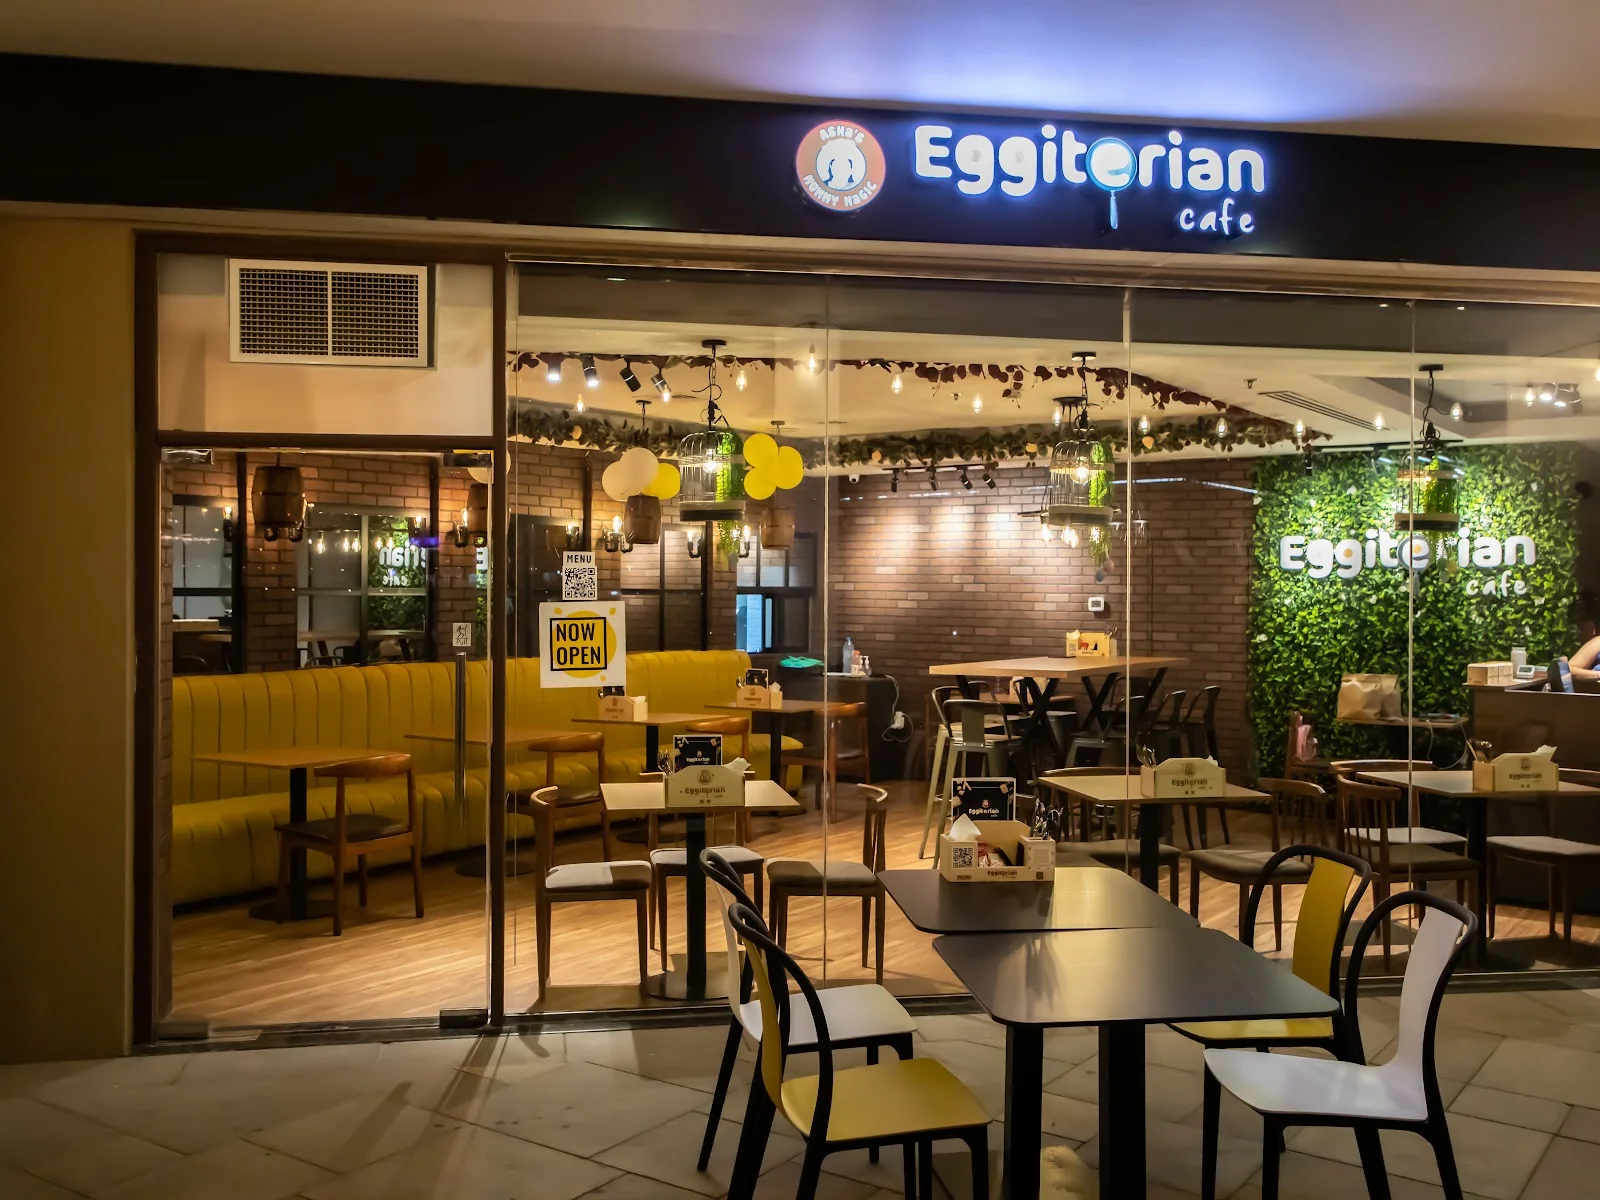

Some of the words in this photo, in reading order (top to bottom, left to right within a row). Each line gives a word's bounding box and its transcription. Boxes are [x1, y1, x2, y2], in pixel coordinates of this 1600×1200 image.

[914, 124, 1266, 196] Eggiterian
[1179, 198, 1255, 234] cafe
[566, 554, 592, 564] MENU
[1465, 570, 1528, 598] cafe
[556, 623, 595, 642] NOW
[556, 646, 601, 666] OPEN
